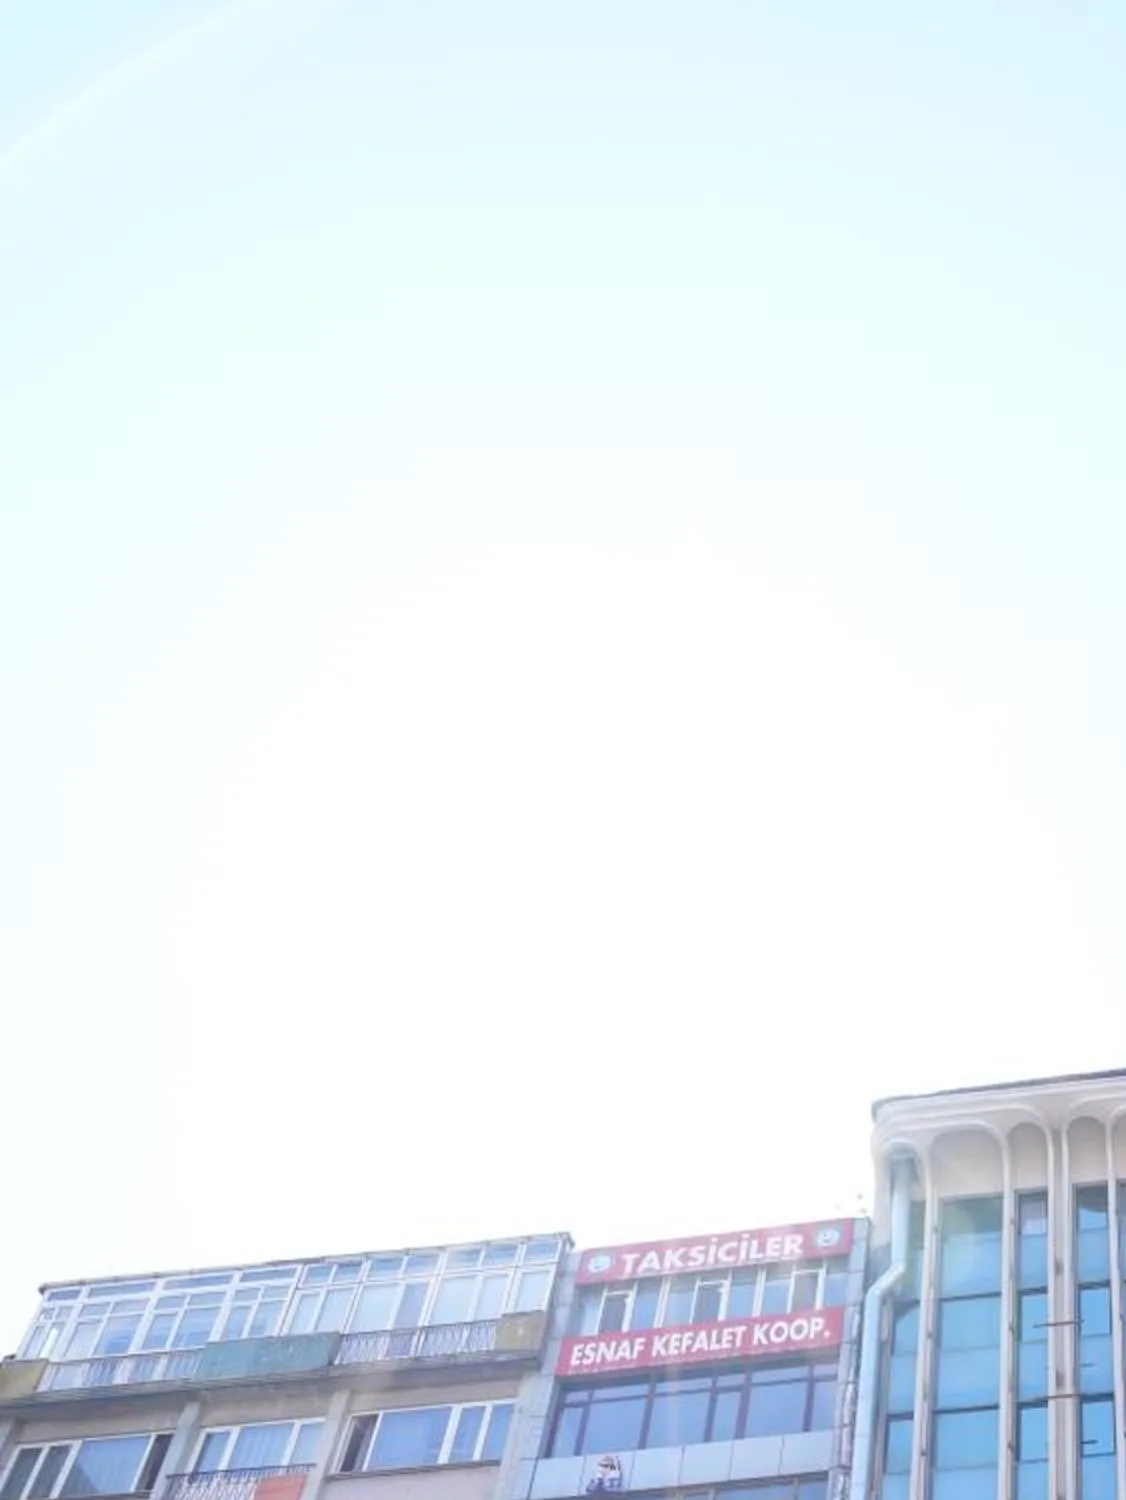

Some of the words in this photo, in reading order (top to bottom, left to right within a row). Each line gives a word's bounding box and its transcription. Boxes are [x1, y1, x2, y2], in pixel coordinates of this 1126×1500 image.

[621, 1233, 804, 1276] TAKSİCİLER
[570, 1336, 645, 1366] ESNAF
[652, 1326, 746, 1357] KEFALET
[753, 1317, 831, 1346] KOOP.
